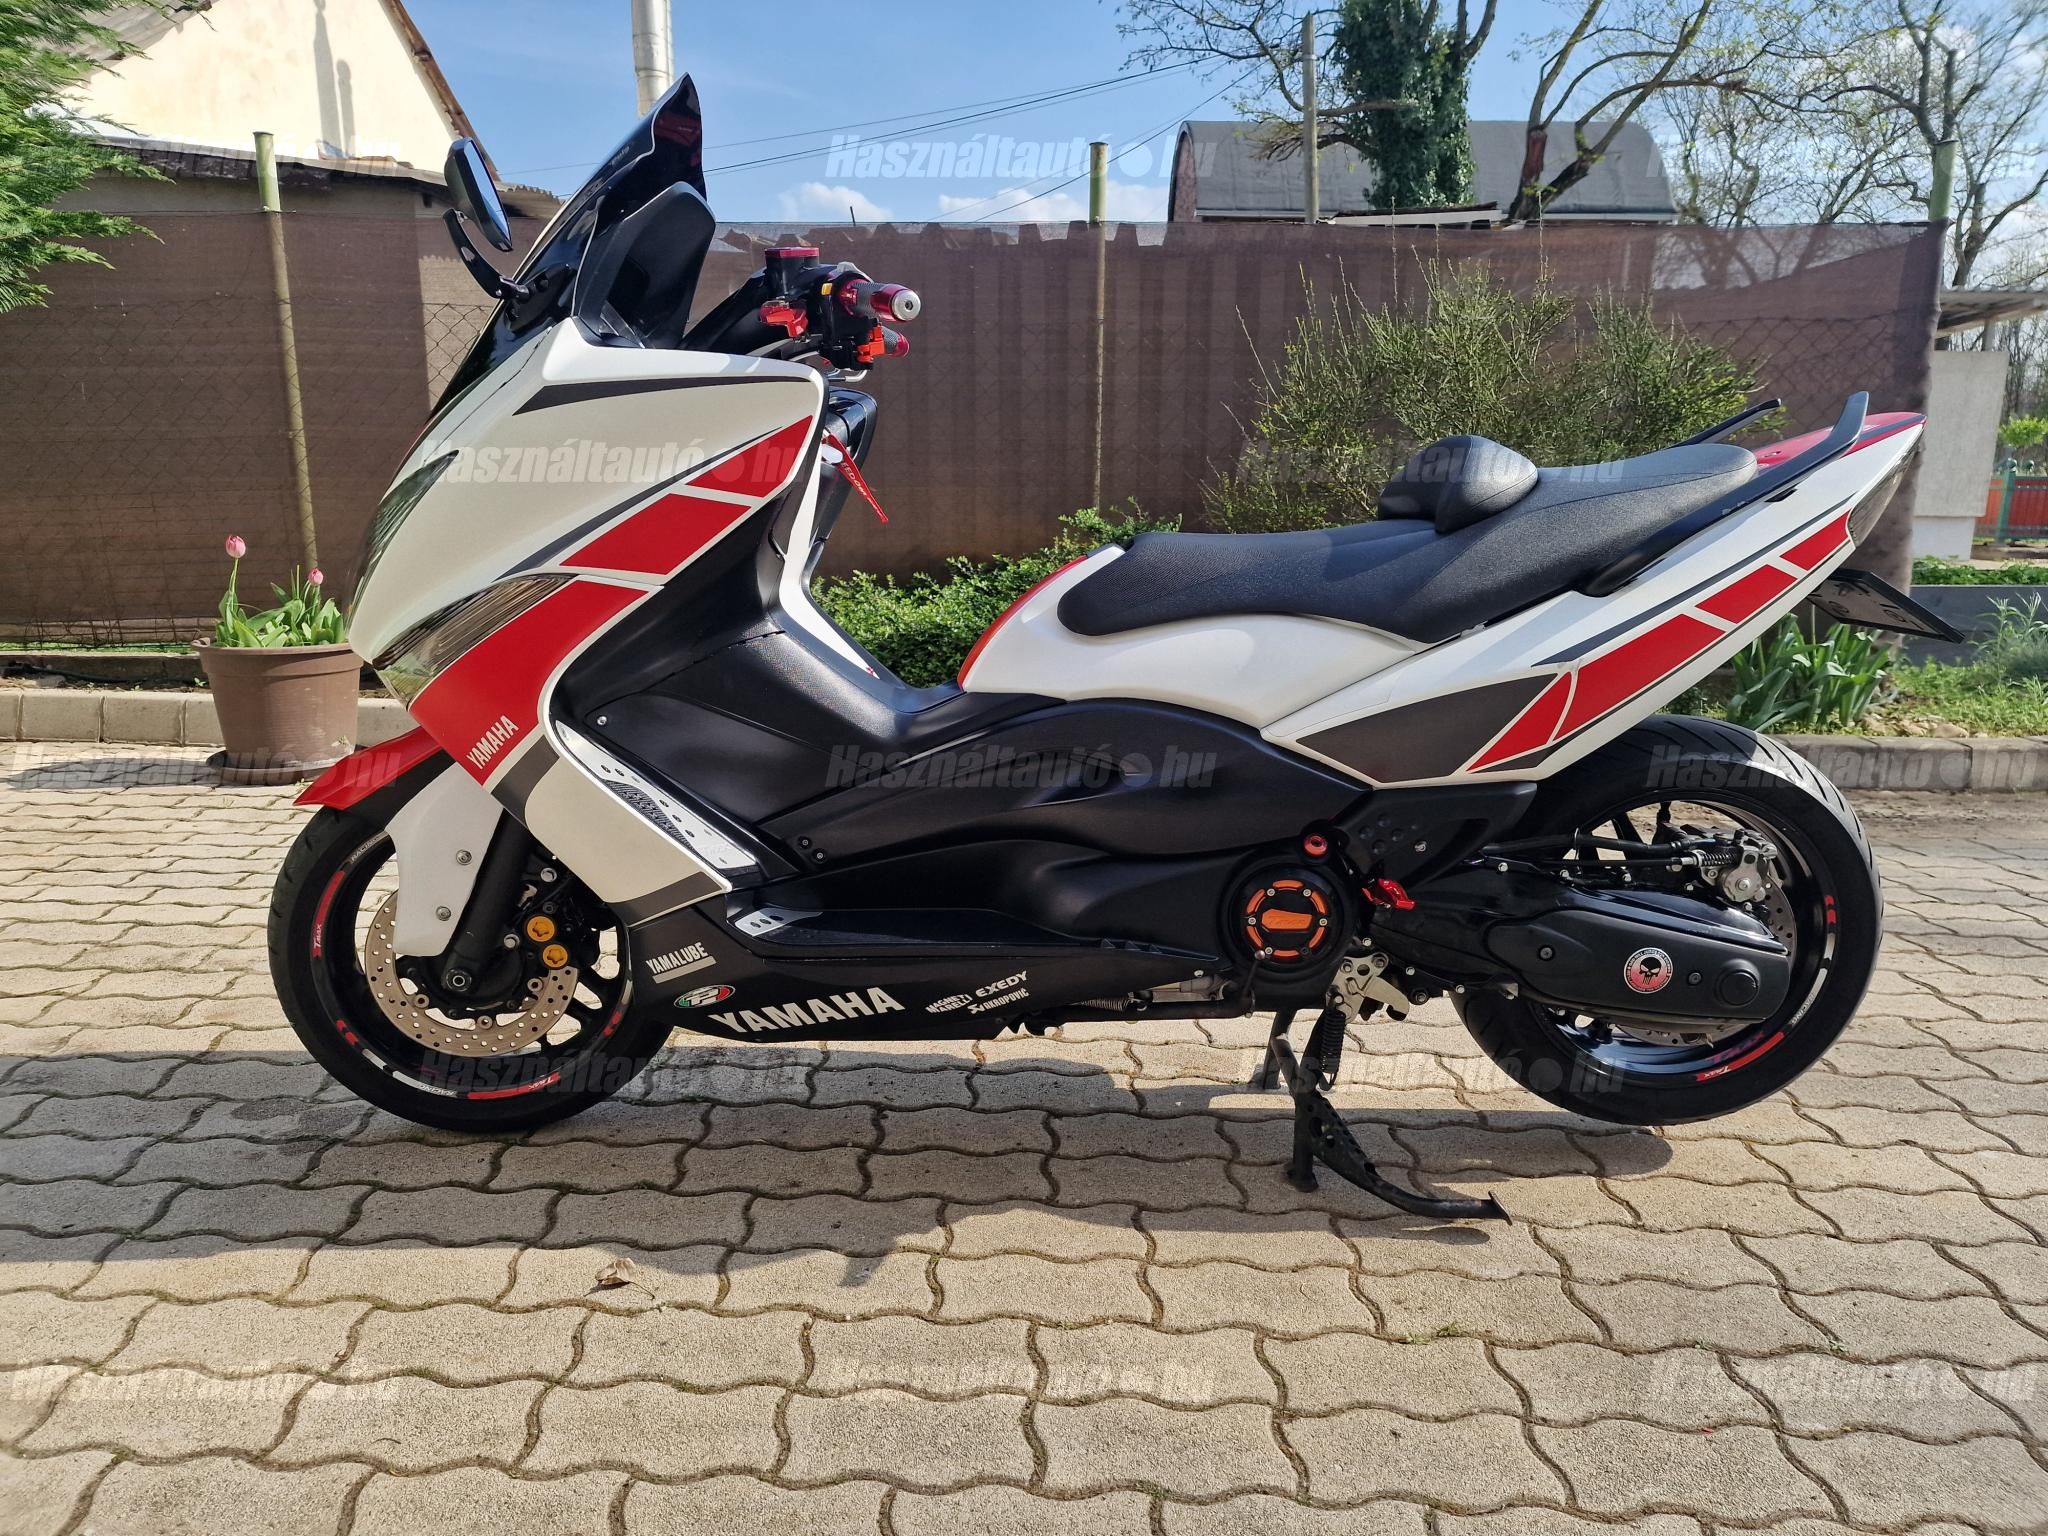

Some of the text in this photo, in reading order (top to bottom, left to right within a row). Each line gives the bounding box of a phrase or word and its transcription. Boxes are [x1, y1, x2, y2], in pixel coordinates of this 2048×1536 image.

[466, 714, 519, 770] YAMAHA
[645, 941, 709, 974] YAMALUBE
[975, 970, 1027, 997] EXEDY
[708, 986, 906, 1033] YAMAHA
